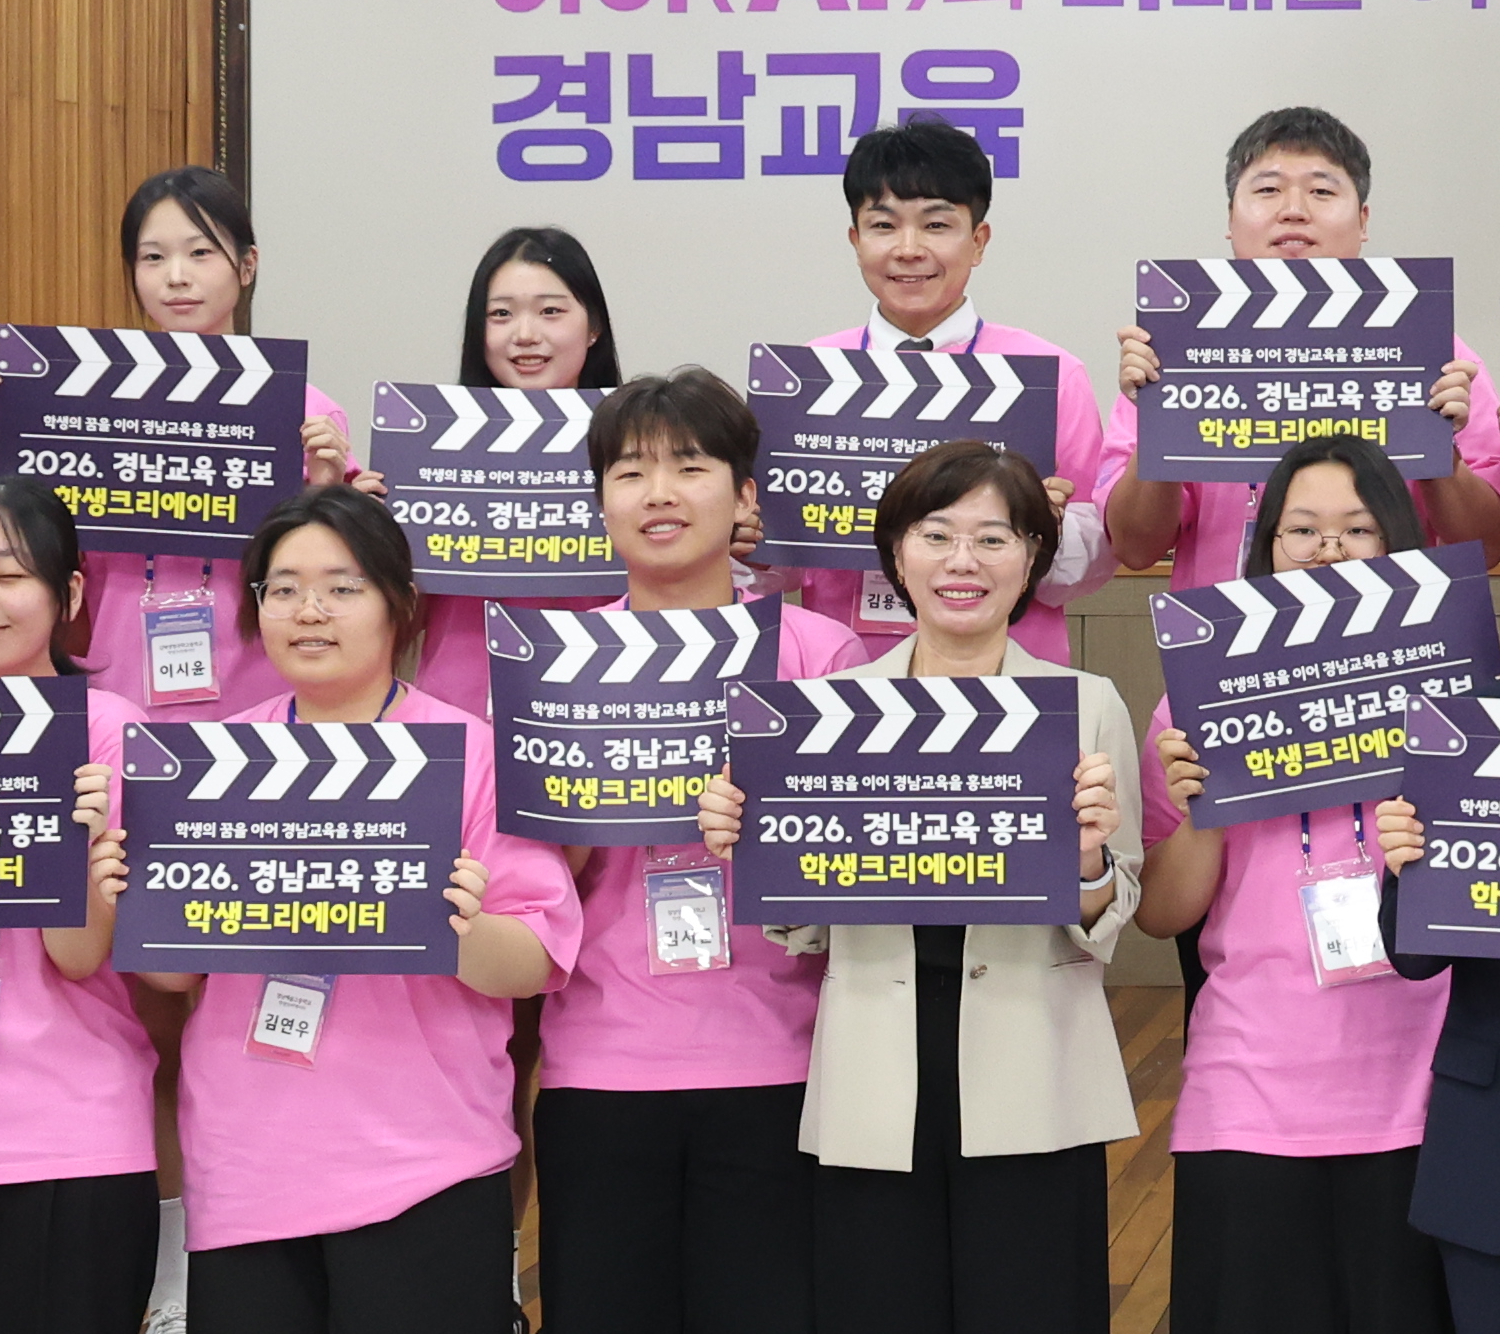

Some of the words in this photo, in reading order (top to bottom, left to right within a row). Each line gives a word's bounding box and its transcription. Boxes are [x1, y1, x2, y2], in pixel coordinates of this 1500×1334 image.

[491, 49, 1024, 182] 경남교육
[44, 415, 81, 430] 학생의
[85, 417, 110, 432] 꿈을
[114, 419, 138, 433] 이어
[142, 420, 203, 437] 경남교육을
[206, 423, 254, 439] 홍보하다
[19, 450, 103, 478] 2026.
[113, 453, 216, 486] 경남교육
[223, 458, 274, 488] 홍보
[54, 486, 235, 522] 학생크리에이터
[160, 660, 206, 679] 이시윤
[8, 813, 61, 848] 홍보
[175, 822, 216, 838] 학생의
[220, 822, 248, 838] 꿈을
[251, 822, 278, 838] 이어
[282, 822, 349, 839] 경남교육을
[352, 822, 406, 839] 홍보하다
[147, 862, 238, 891] 2026.
[249, 859, 363, 893] 경남교육
[371, 859, 427, 894] 홍보
[185, 901, 385, 934] 학생크리에이터
[264, 1012, 309, 1038] 김연우
